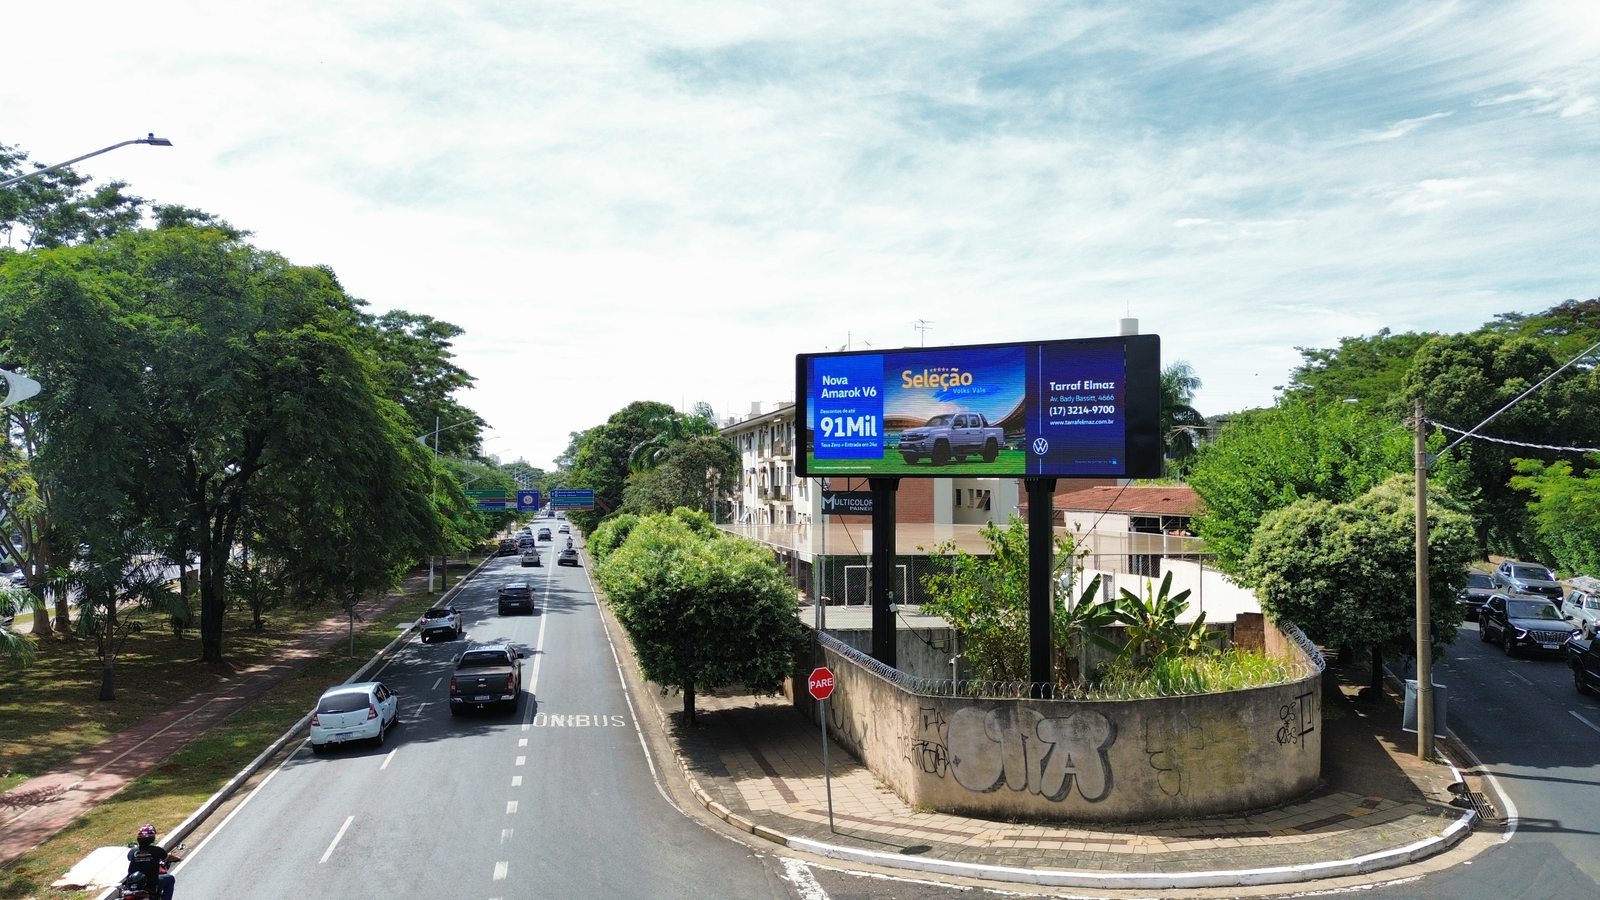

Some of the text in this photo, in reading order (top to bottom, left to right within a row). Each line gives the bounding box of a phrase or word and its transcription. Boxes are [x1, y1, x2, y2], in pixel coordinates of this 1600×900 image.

[822, 375, 848, 386] Nova
[901, 368, 973, 393] Seleção
[1049, 380, 1115, 391] Tarraf Elmaz
[821, 386, 877, 399] Amarok V6
[1060, 395, 1075, 404] Bady
[1049, 405, 1115, 417] (17) 3214-9700
[820, 414, 877, 437] 91Mil
[810, 677, 833, 690] PARE
[532, 712, 626, 728] ÔNIBUS
